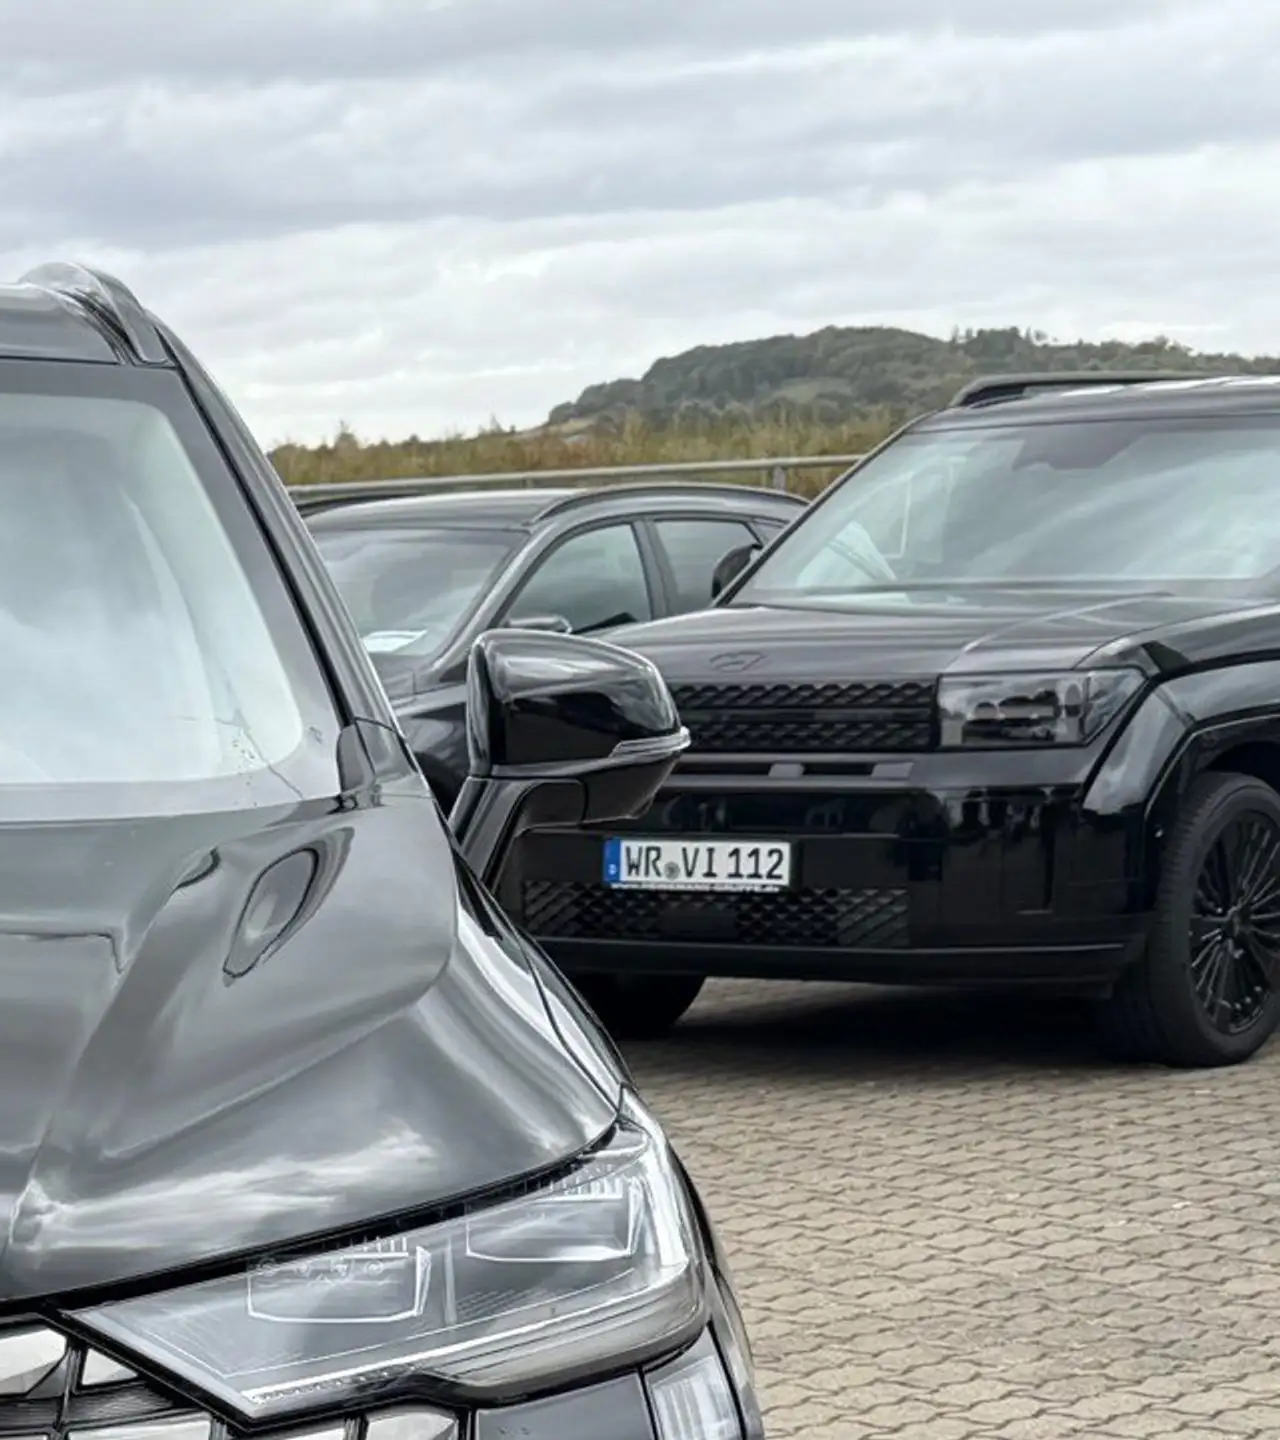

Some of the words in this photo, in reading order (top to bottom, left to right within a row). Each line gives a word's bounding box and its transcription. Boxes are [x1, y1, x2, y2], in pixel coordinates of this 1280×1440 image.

[625, 846, 662, 877] WR
[681, 847, 718, 878] VI
[727, 847, 784, 879] 112
